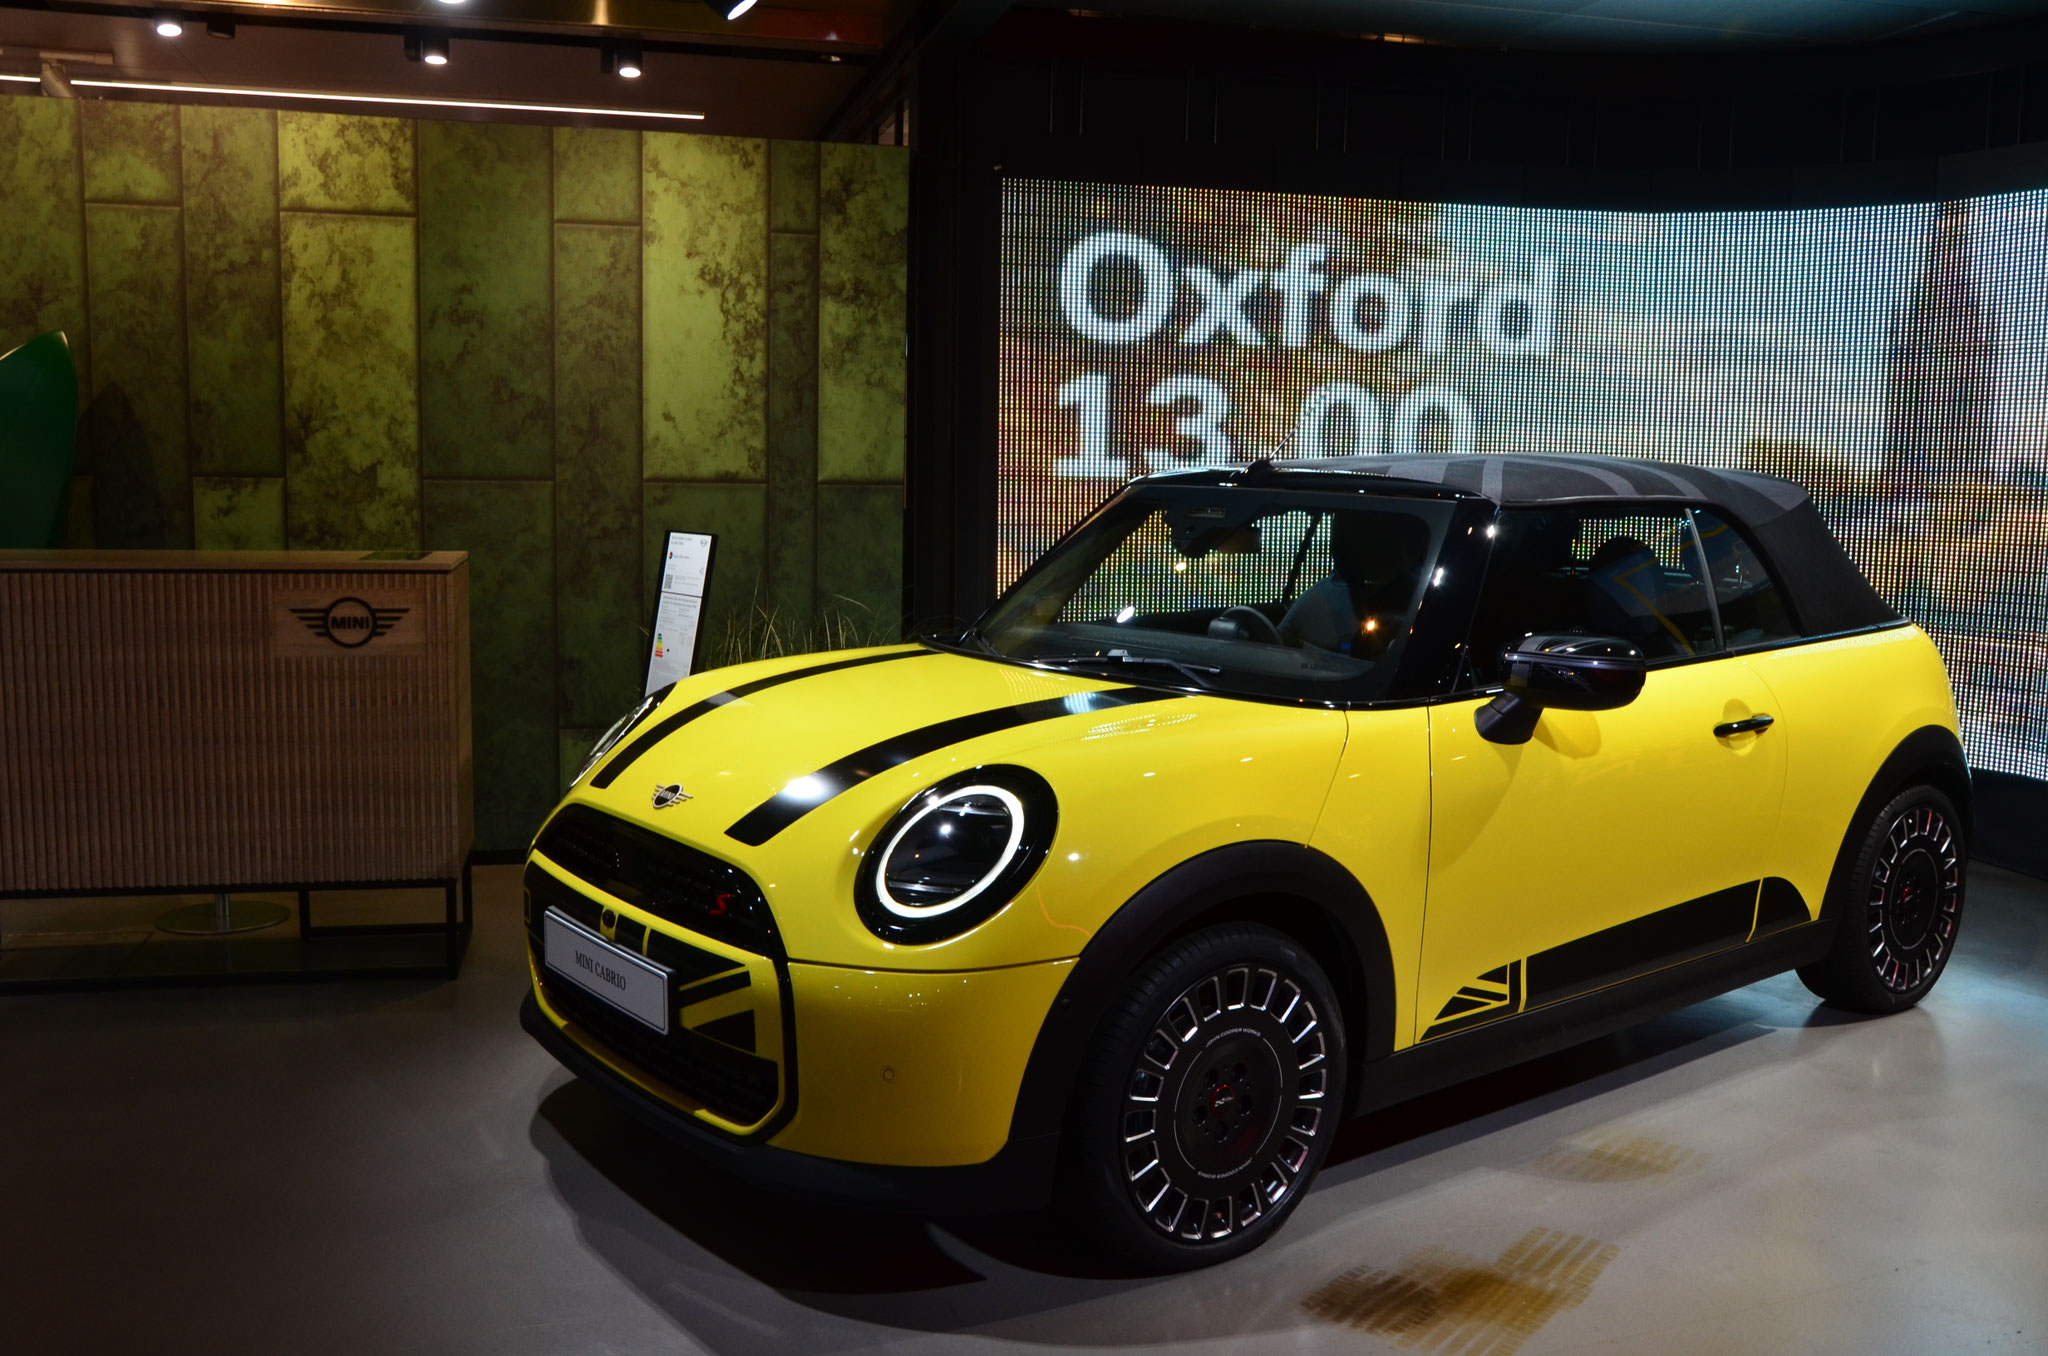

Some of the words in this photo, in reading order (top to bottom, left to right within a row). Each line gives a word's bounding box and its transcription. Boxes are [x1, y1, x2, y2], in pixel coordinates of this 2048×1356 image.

[1058, 230, 1558, 358] Oxford
[1052, 372, 1478, 478] 1300
[330, 615, 371, 630] MINI
[708, 892, 734, 918] S
[575, 950, 594, 973] MINI
[594, 962, 626, 991] CABRIO
[1220, 1027, 1243, 1038] COOPER
[1243, 1028, 1261, 1037] WORKS
